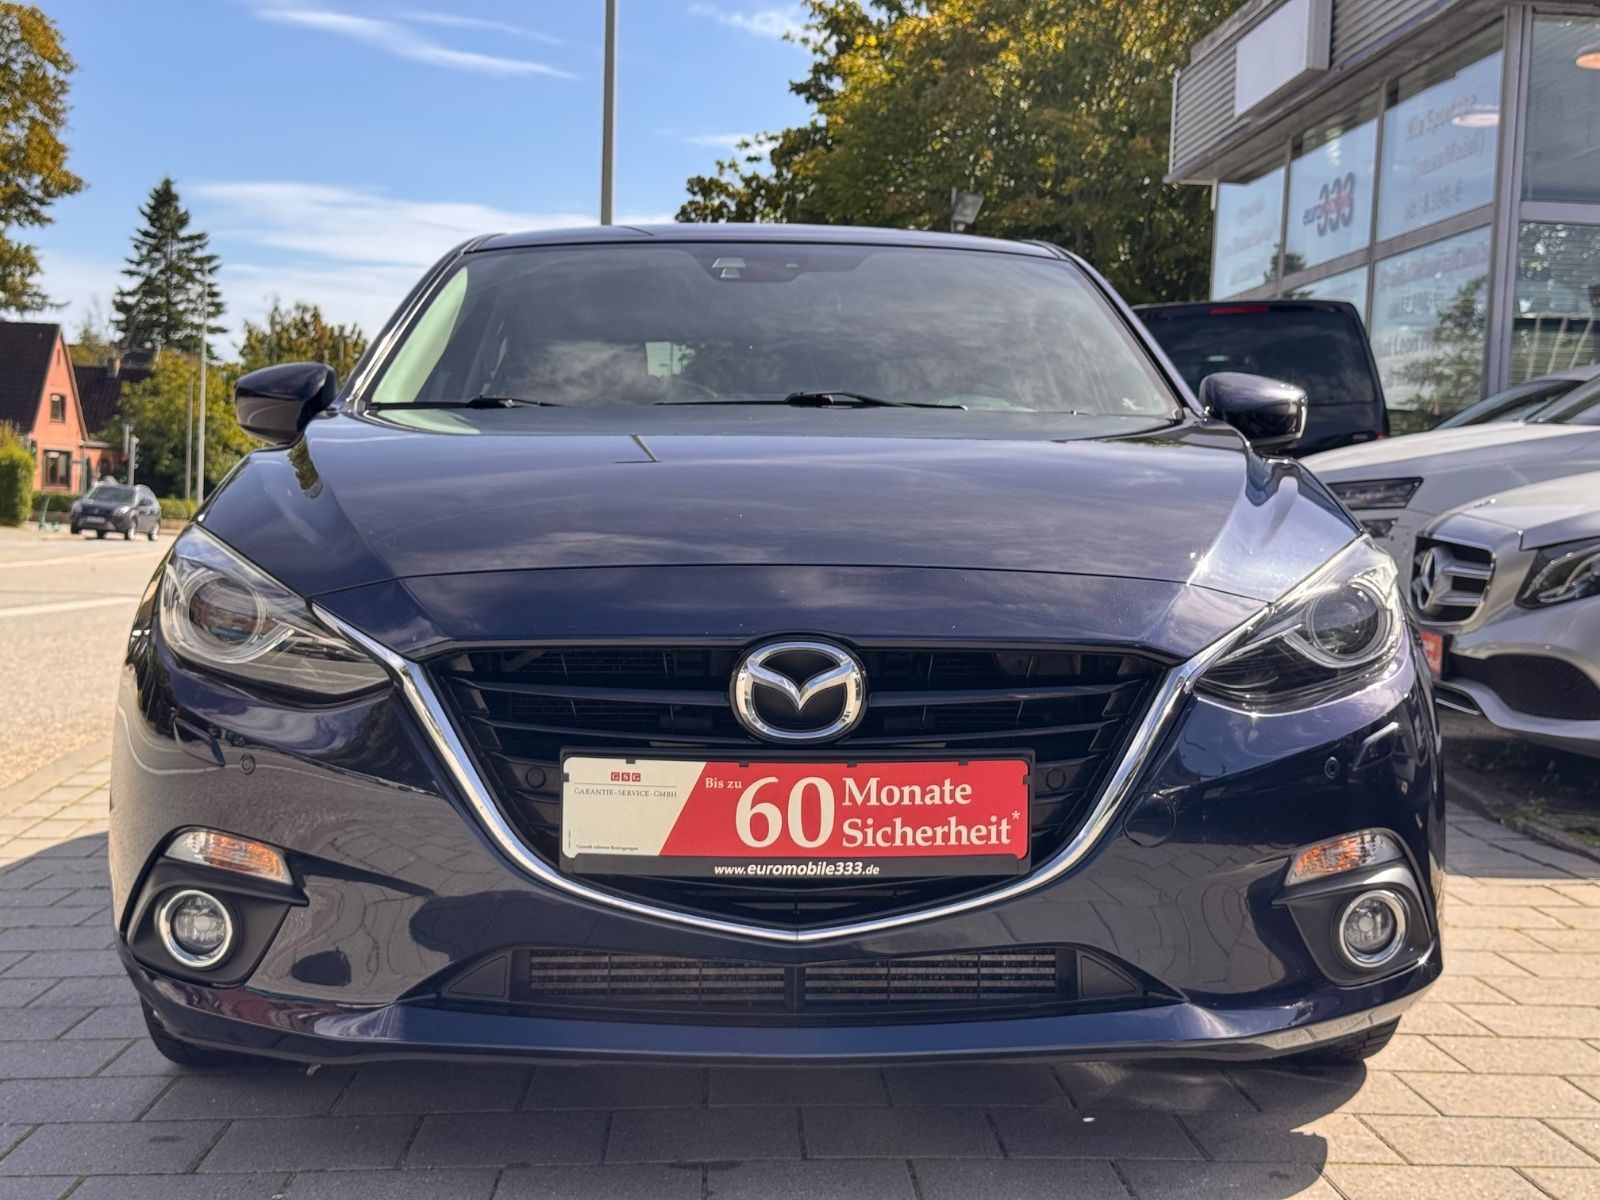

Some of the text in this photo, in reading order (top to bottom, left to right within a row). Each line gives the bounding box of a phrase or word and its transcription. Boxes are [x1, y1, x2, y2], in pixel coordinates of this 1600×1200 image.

[611, 772, 641, 782] GSG
[705, 777, 742, 789] Bis zu
[842, 777, 972, 806] Monate
[735, 776, 835, 848] 60
[714, 861, 880, 876] www.euromobile333.de
